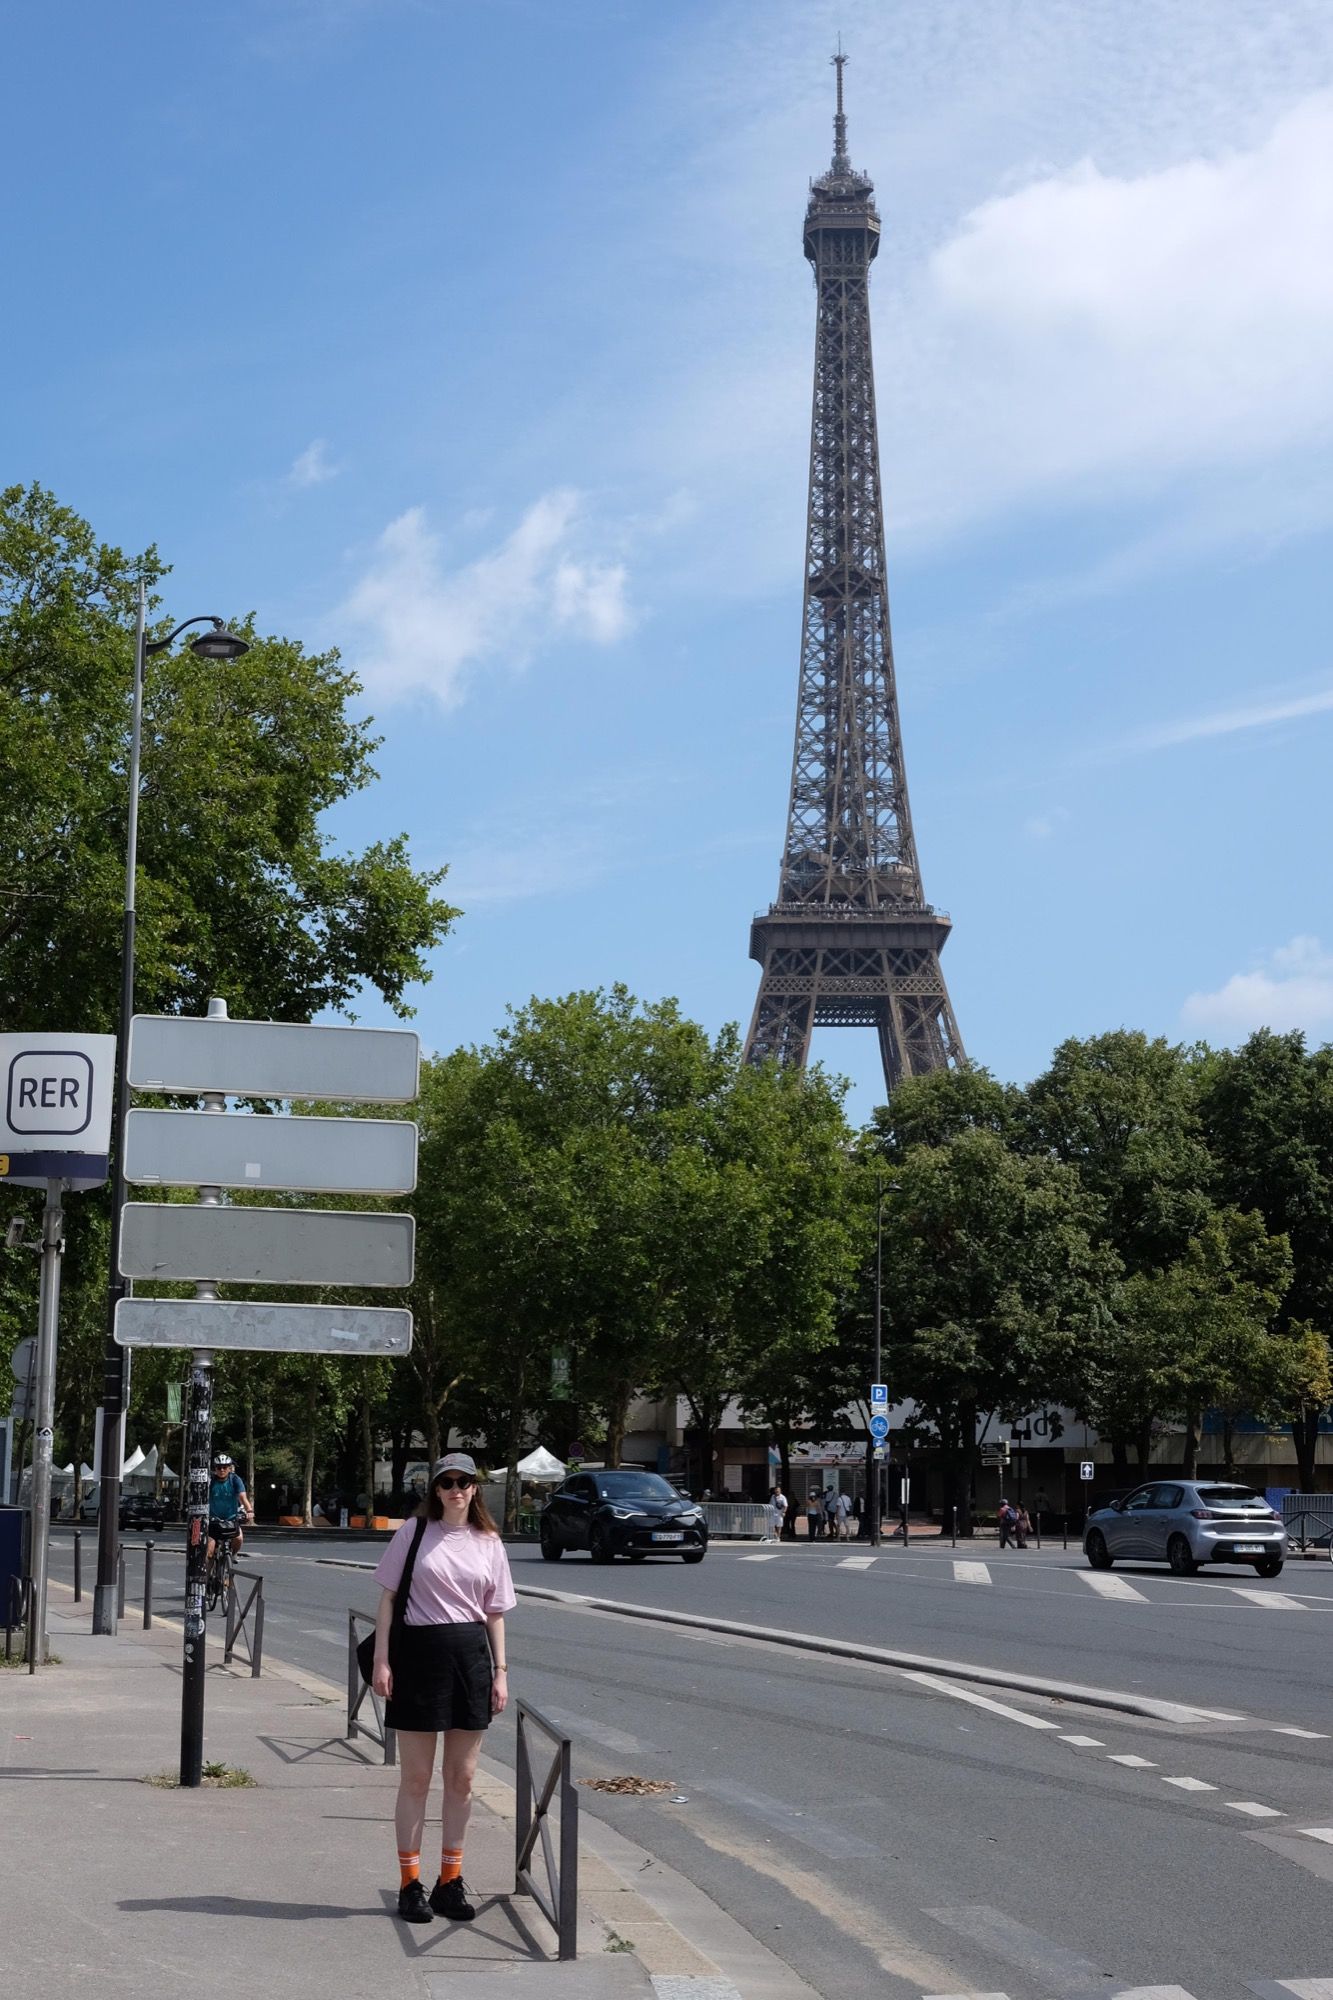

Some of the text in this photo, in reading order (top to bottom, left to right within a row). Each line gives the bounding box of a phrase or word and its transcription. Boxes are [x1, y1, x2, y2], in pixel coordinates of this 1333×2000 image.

[19, 1077, 80, 1108] RER
[552, 1358, 568, 1370] 10
[875, 1388, 883, 1400] P
